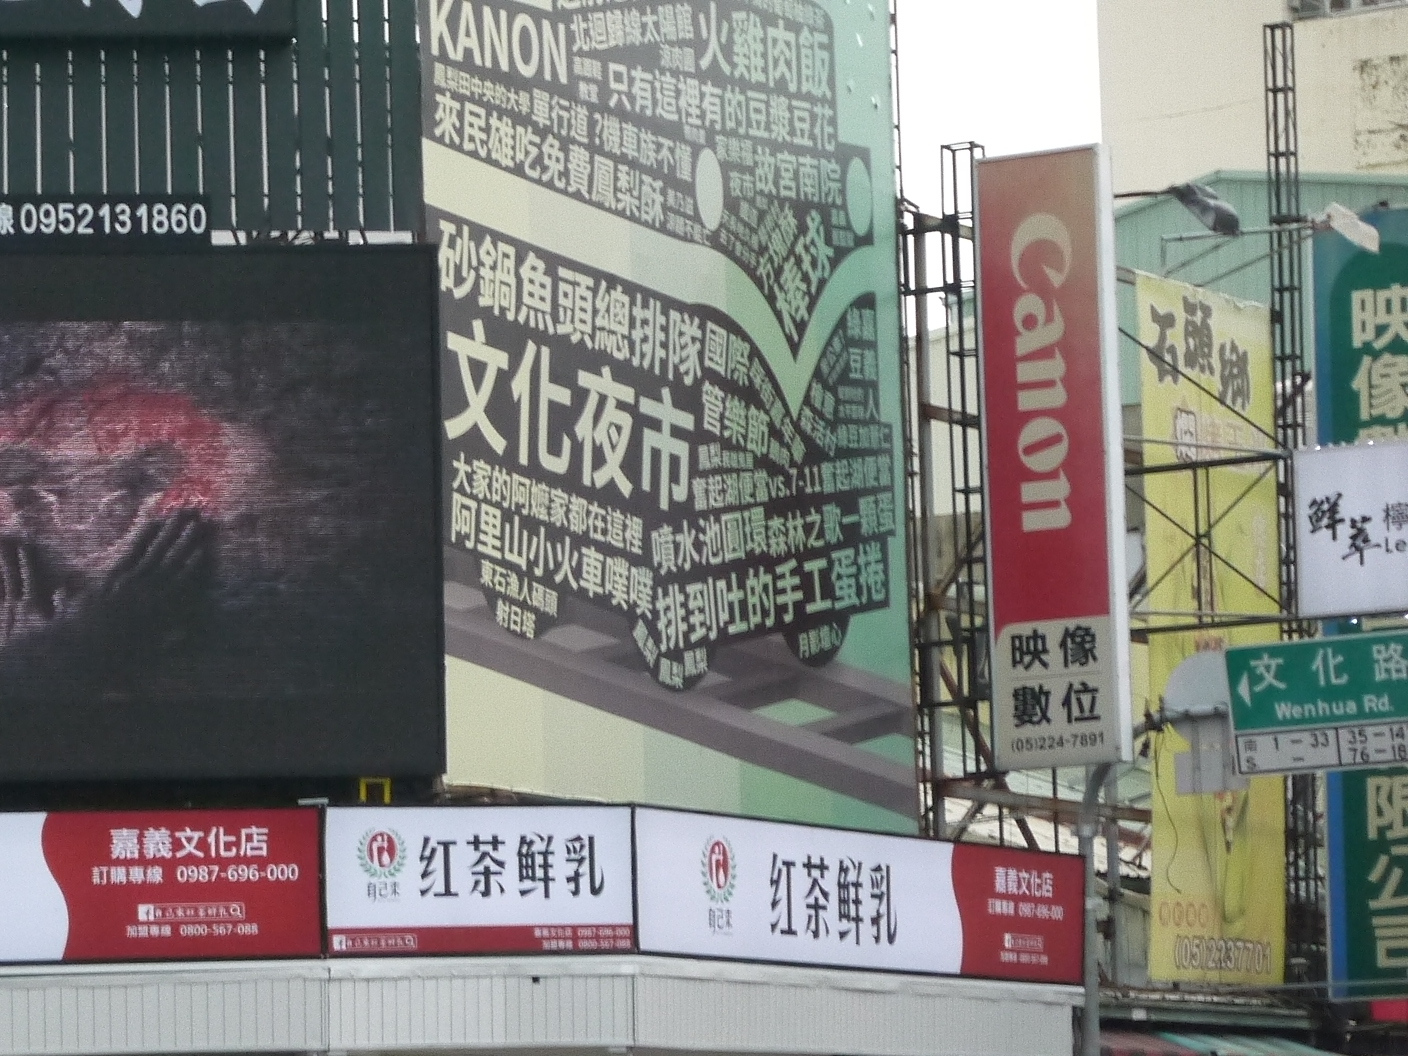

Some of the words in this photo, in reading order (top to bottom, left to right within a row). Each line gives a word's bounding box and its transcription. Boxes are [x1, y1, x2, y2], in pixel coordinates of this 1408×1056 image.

[429, 0, 568, 85] KANON
[698, 1, 832, 101] 火雞肉飯
[608, 62, 836, 151] 只有這裡有的豆漿豆花
[754, 145, 842, 205] 故宮南院
[1010, 211, 1072, 533] Canon
[444, 319, 694, 511] 文化夜市
[1010, 624, 1098, 671] 映像
[1249, 643, 1408, 692] 文化路
[1011, 683, 1102, 728] 數位
[1275, 699, 1358, 721] Wenhua
[1363, 693, 1394, 713] Rd.
[110, 825, 269, 860] 嘉義文化店
[176, 863, 300, 884] 0987-696-000
